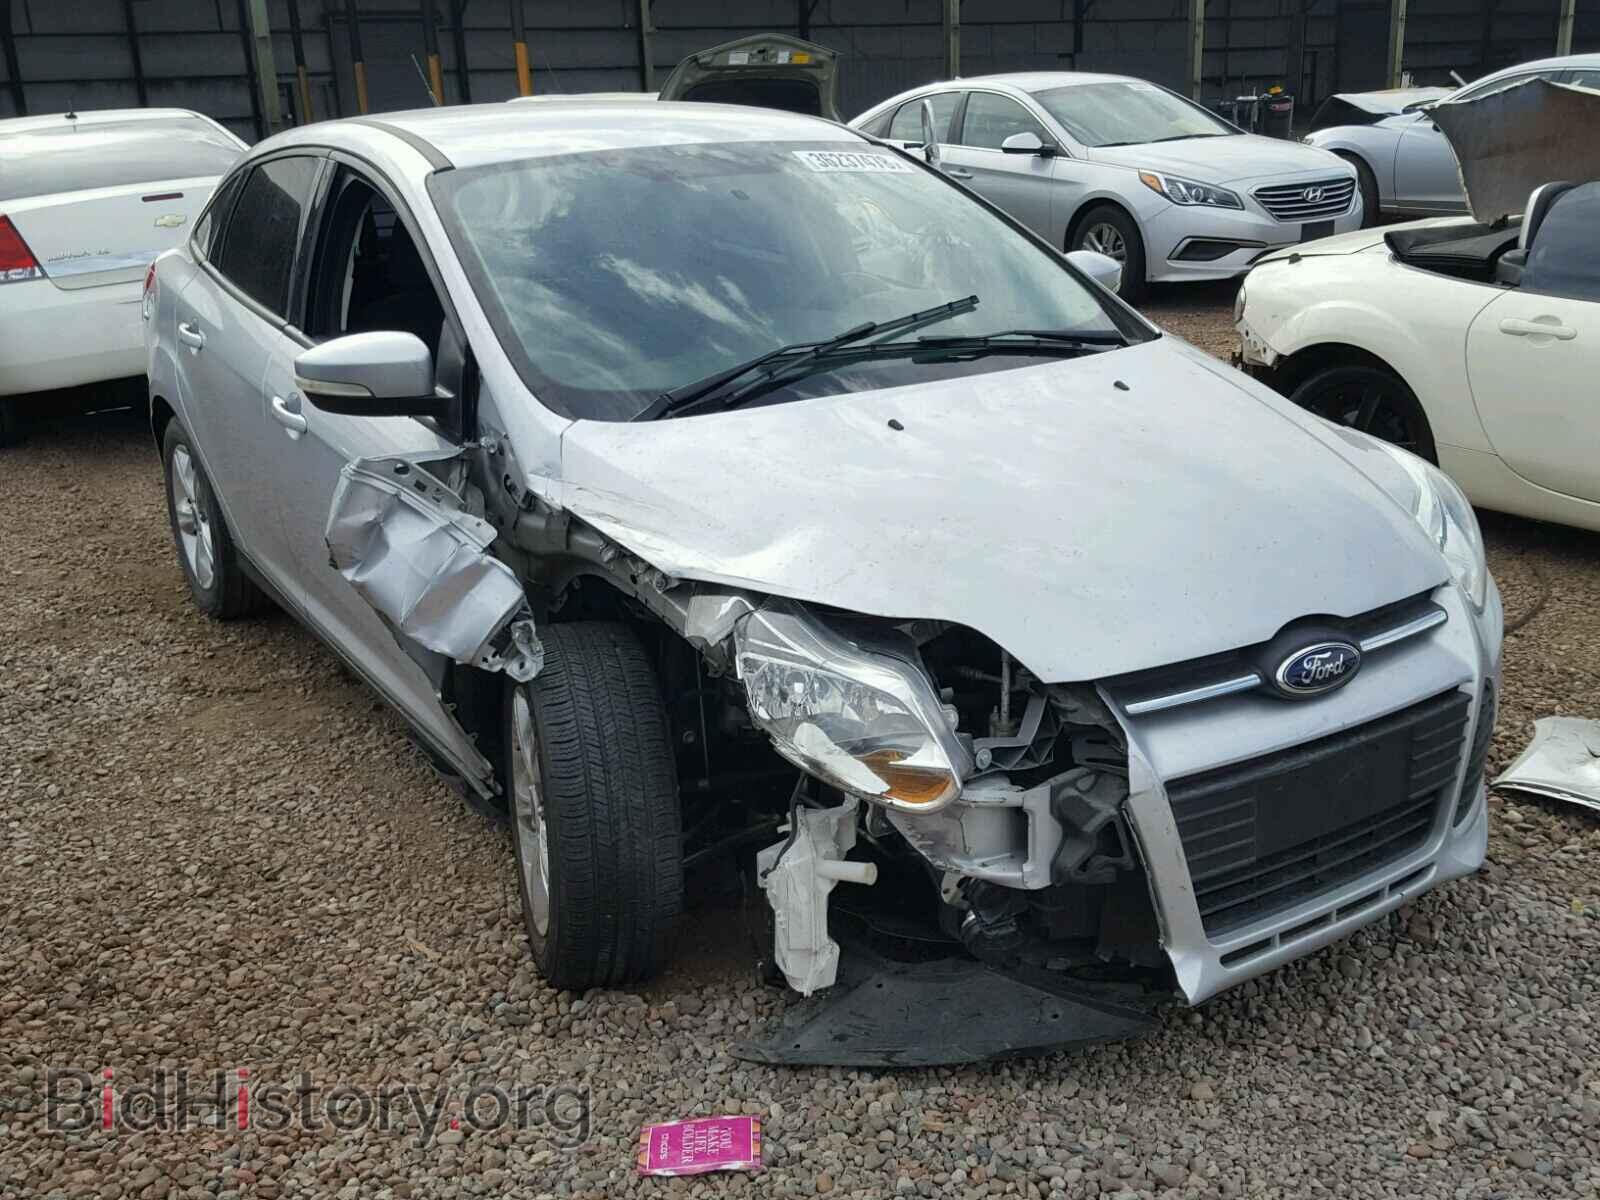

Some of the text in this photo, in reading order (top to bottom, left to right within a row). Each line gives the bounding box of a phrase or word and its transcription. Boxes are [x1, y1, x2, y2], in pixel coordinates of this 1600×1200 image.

[1301, 651, 1344, 684] Ford
[681, 1124, 695, 1164] BOLDER
[694, 1129, 707, 1154] LIFE
[707, 1125, 720, 1156] MAKE
[719, 1127, 733, 1149] YOU
